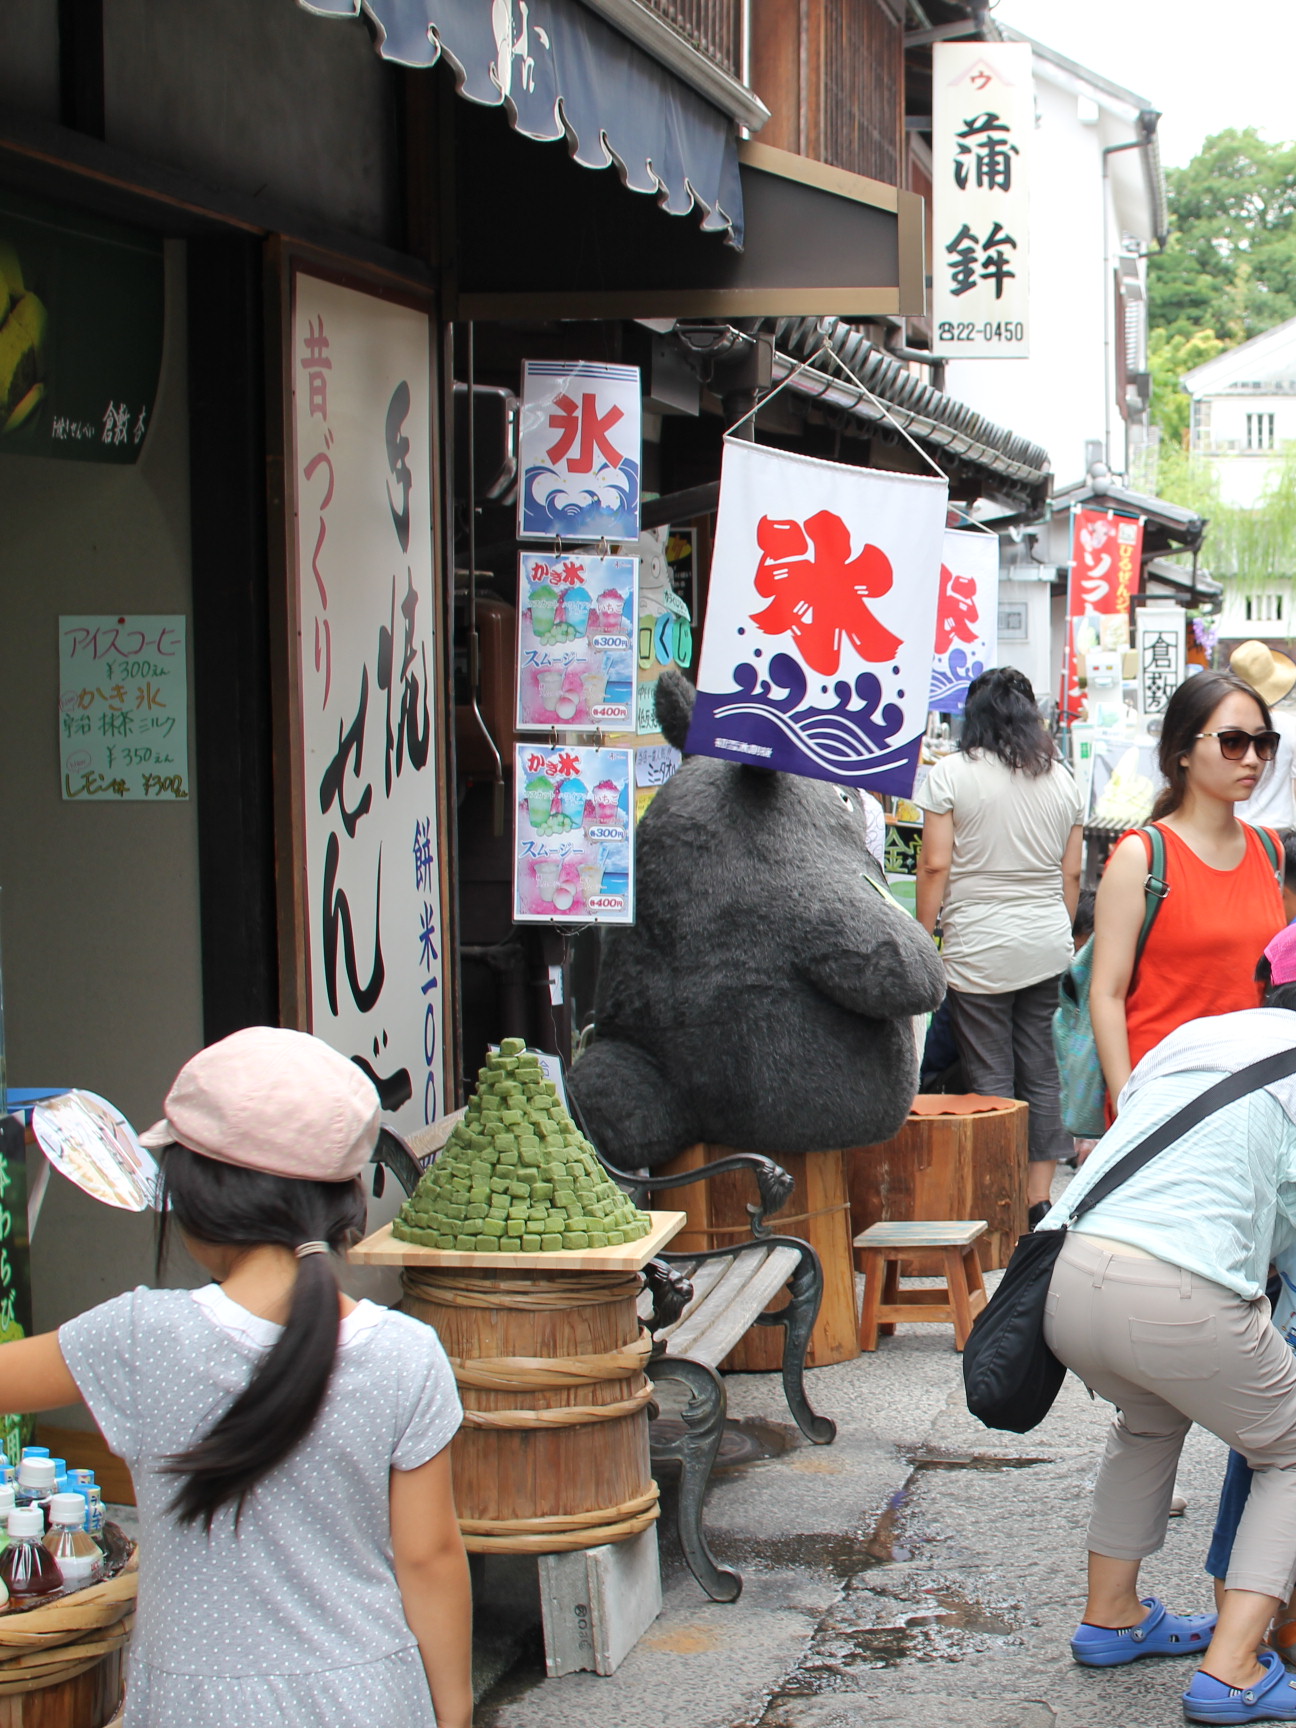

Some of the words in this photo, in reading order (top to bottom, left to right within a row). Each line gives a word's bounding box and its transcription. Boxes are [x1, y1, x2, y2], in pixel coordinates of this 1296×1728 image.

[945, 111, 1020, 300] 蒲鉾
[956, 321, 1024, 343] 22-0450
[547, 392, 625, 474] 氷
[300, 313, 335, 712] 昔づくり
[531, 561, 585, 586] かき氷
[748, 508, 904, 676] 氷
[1116, 544, 1134, 613] ひるぜんジ
[523, 650, 587, 667] スムージー
[77, 681, 166, 711] かき氷
[528, 752, 581, 777] かき氷
[520, 840, 584, 858] スムージー
[412, 815, 439, 1168] 餅米一〇〇
